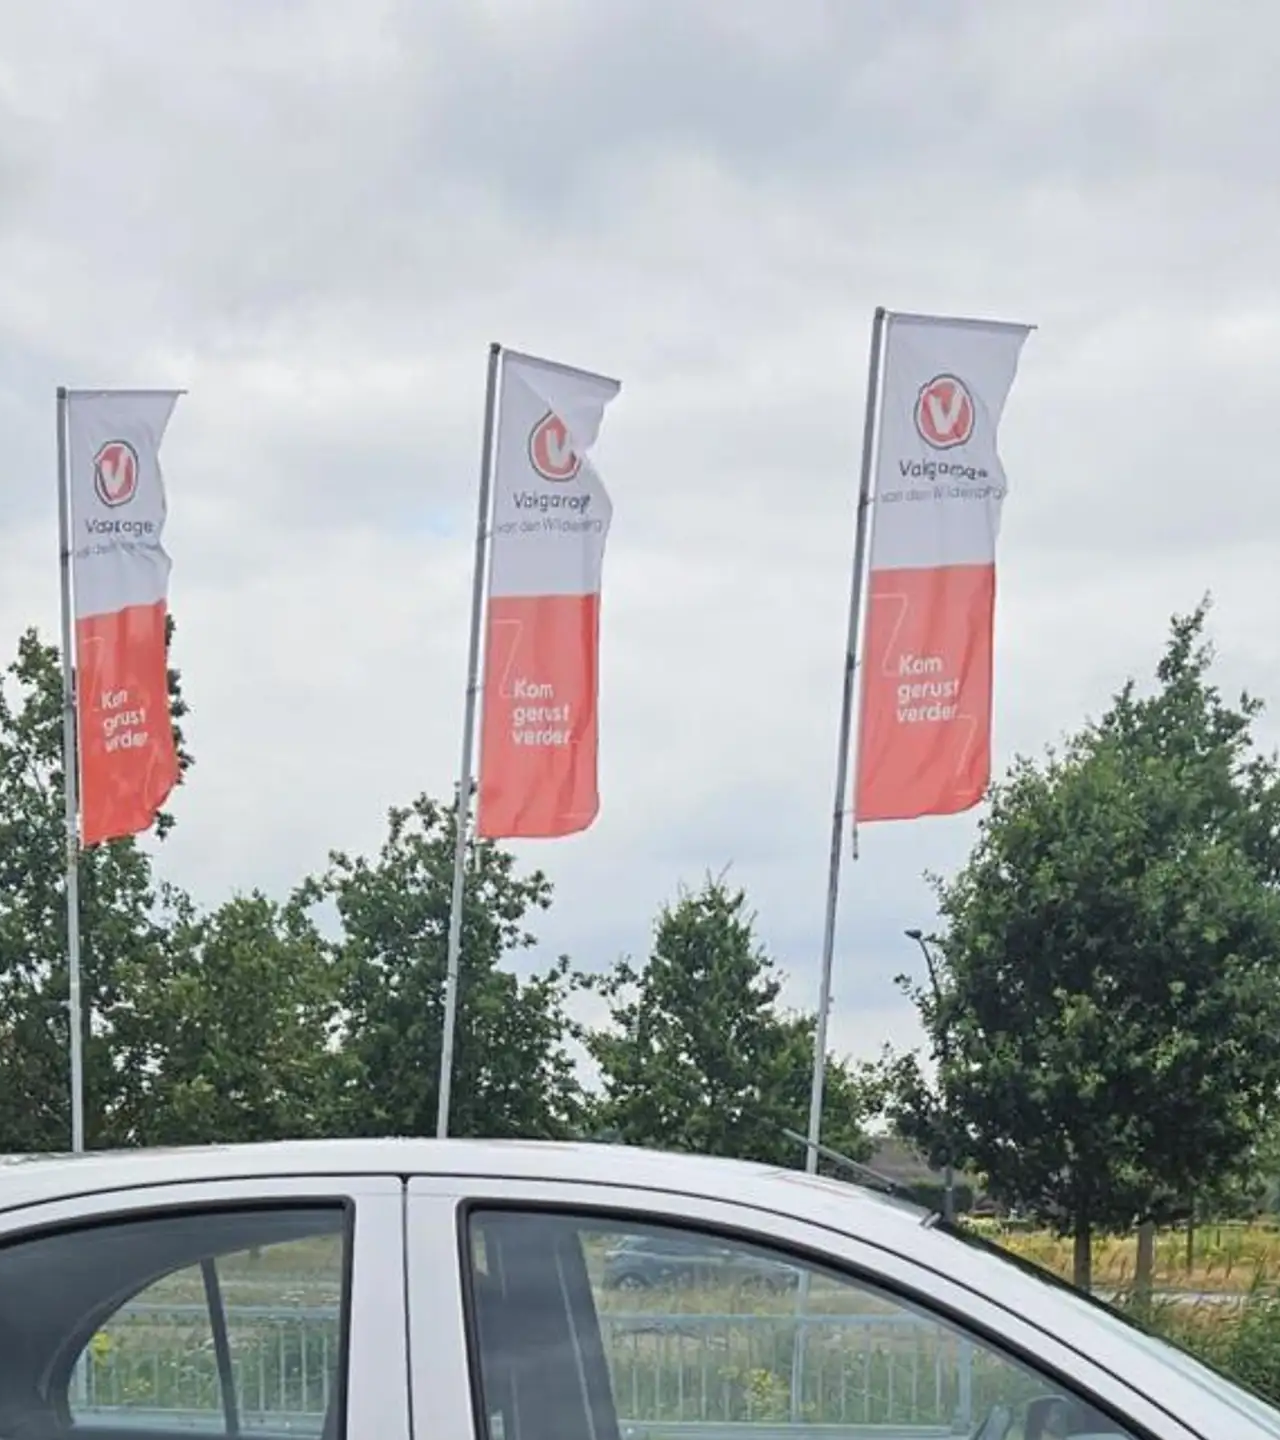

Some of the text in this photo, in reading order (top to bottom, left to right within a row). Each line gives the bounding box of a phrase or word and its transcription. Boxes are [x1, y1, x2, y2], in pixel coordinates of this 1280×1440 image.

[899, 653, 942, 676] Kom
[514, 676, 555, 699] Kom
[897, 678, 960, 705] gerust
